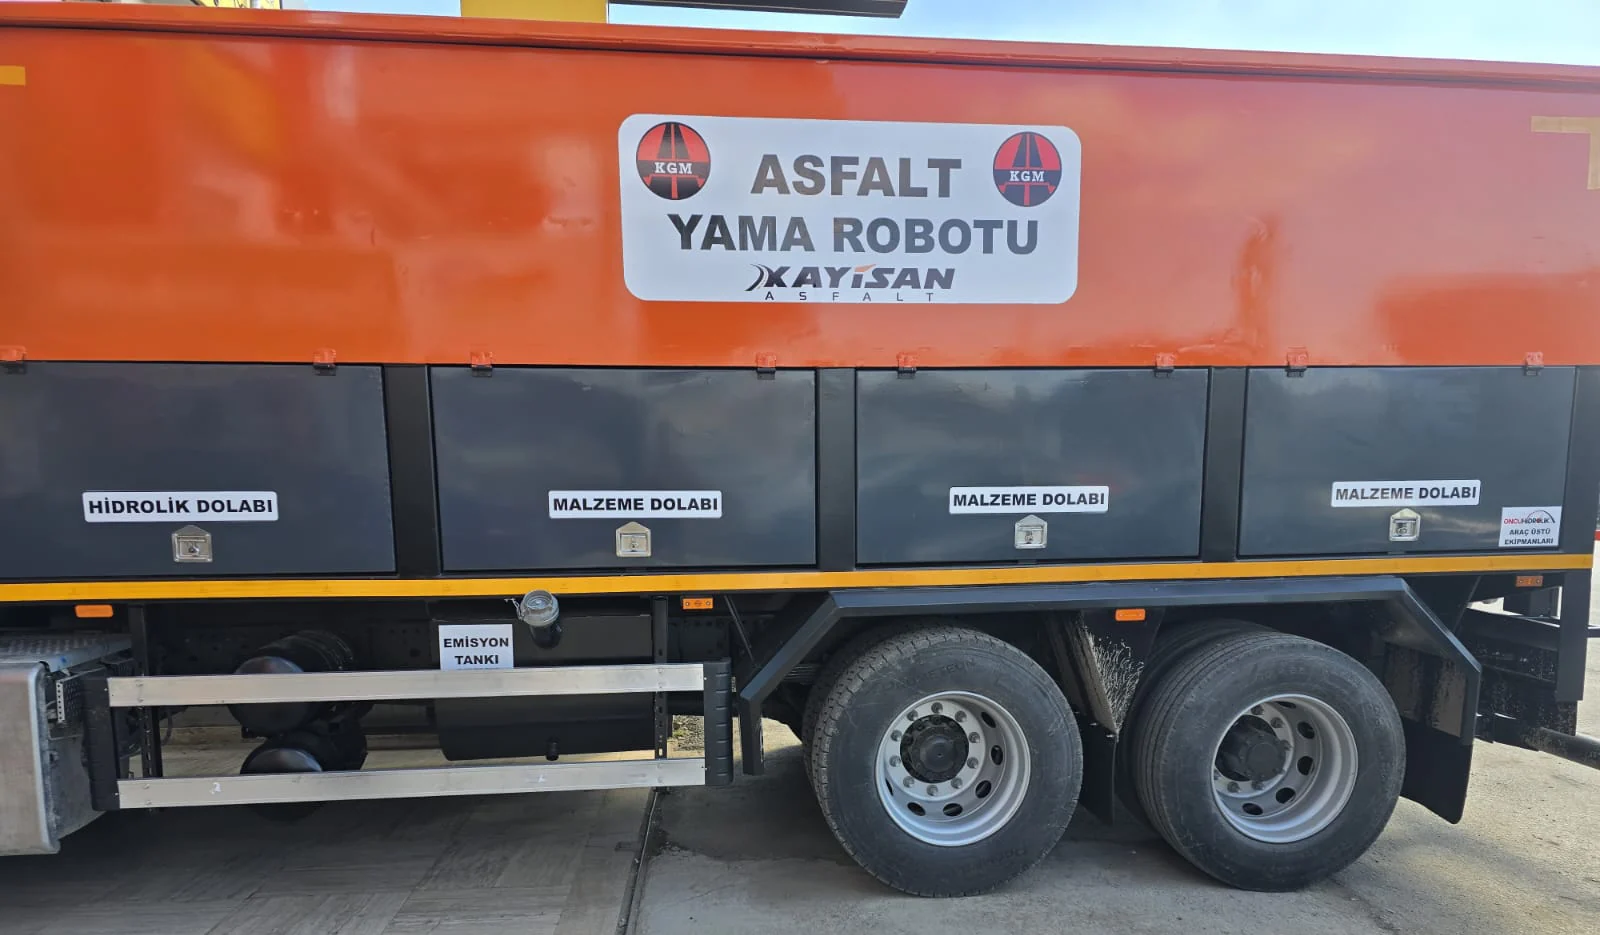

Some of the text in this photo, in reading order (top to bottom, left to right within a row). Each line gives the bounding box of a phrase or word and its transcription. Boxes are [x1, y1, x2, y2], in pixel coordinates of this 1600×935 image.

[654, 161, 693, 174] KGM
[750, 154, 962, 198] ASFALT
[1009, 170, 1045, 182] KGM
[667, 213, 1039, 255] YAMA ROBOTU
[765, 291, 934, 302] ASFALT
[953, 492, 1105, 506] MALZEME DOLABI
[1335, 486, 1476, 500] MALZEME DOLABI
[88, 496, 273, 514] HİDROLİK DOLABI
[553, 498, 718, 511] MALZEME DOLABI
[443, 635, 509, 648] EMİSYON
[454, 655, 499, 665] TANKI
